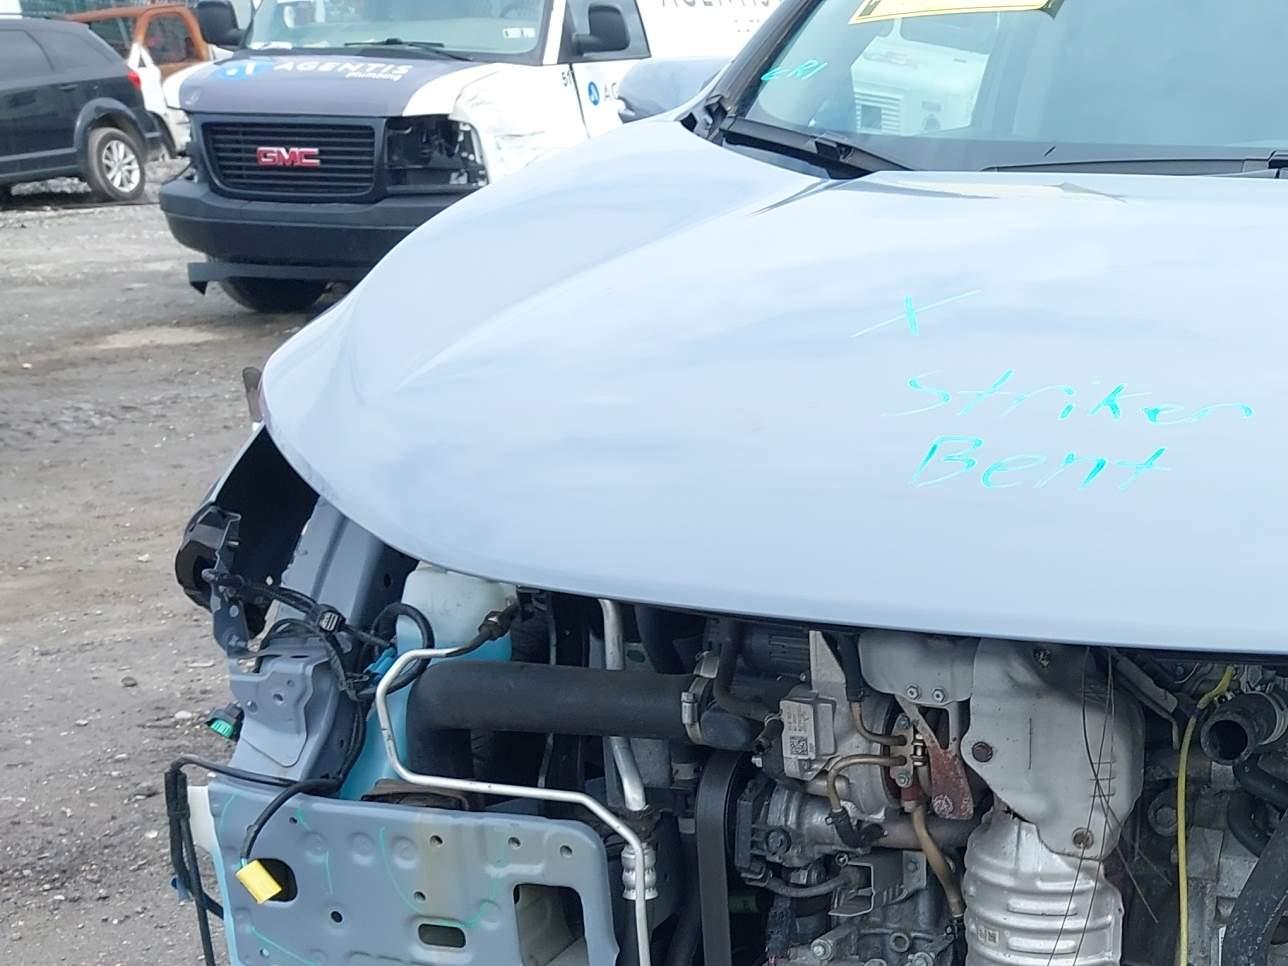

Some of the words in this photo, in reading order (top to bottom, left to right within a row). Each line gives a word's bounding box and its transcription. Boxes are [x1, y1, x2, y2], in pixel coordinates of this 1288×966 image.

[273, 62, 414, 75] AGENTIS
[257, 146, 320, 168] GMC
[911, 434, 1171, 491] Bent
